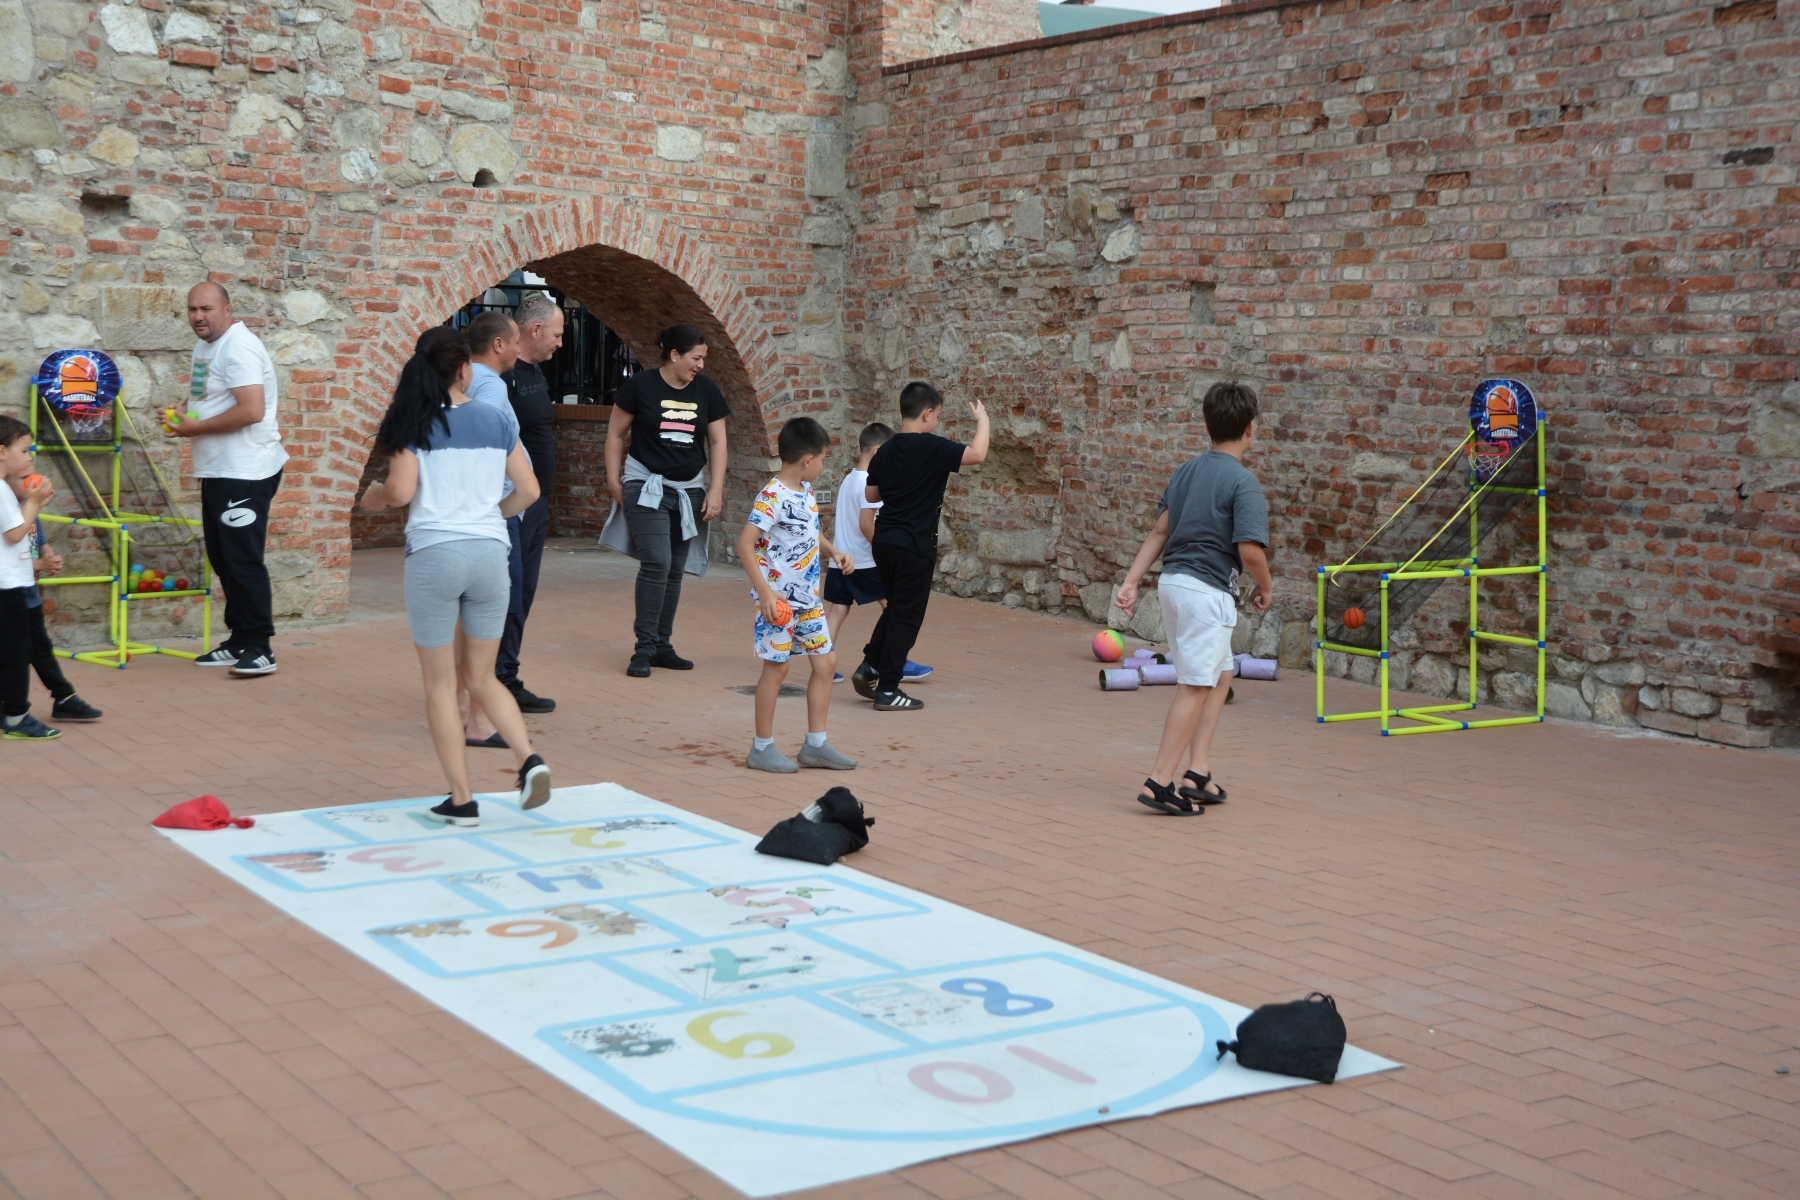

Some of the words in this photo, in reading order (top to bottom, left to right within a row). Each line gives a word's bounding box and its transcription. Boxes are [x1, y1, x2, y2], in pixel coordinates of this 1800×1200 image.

[62, 393, 97, 402] BASKETBALL
[1490, 428, 1518, 438] BASKETBALL
[532, 827, 626, 849] 2
[347, 845, 446, 872] 3
[516, 871, 604, 893] 4
[722, 887, 815, 921] 5
[939, 977, 1055, 1017] 8
[907, 1044, 1098, 1104] 10
